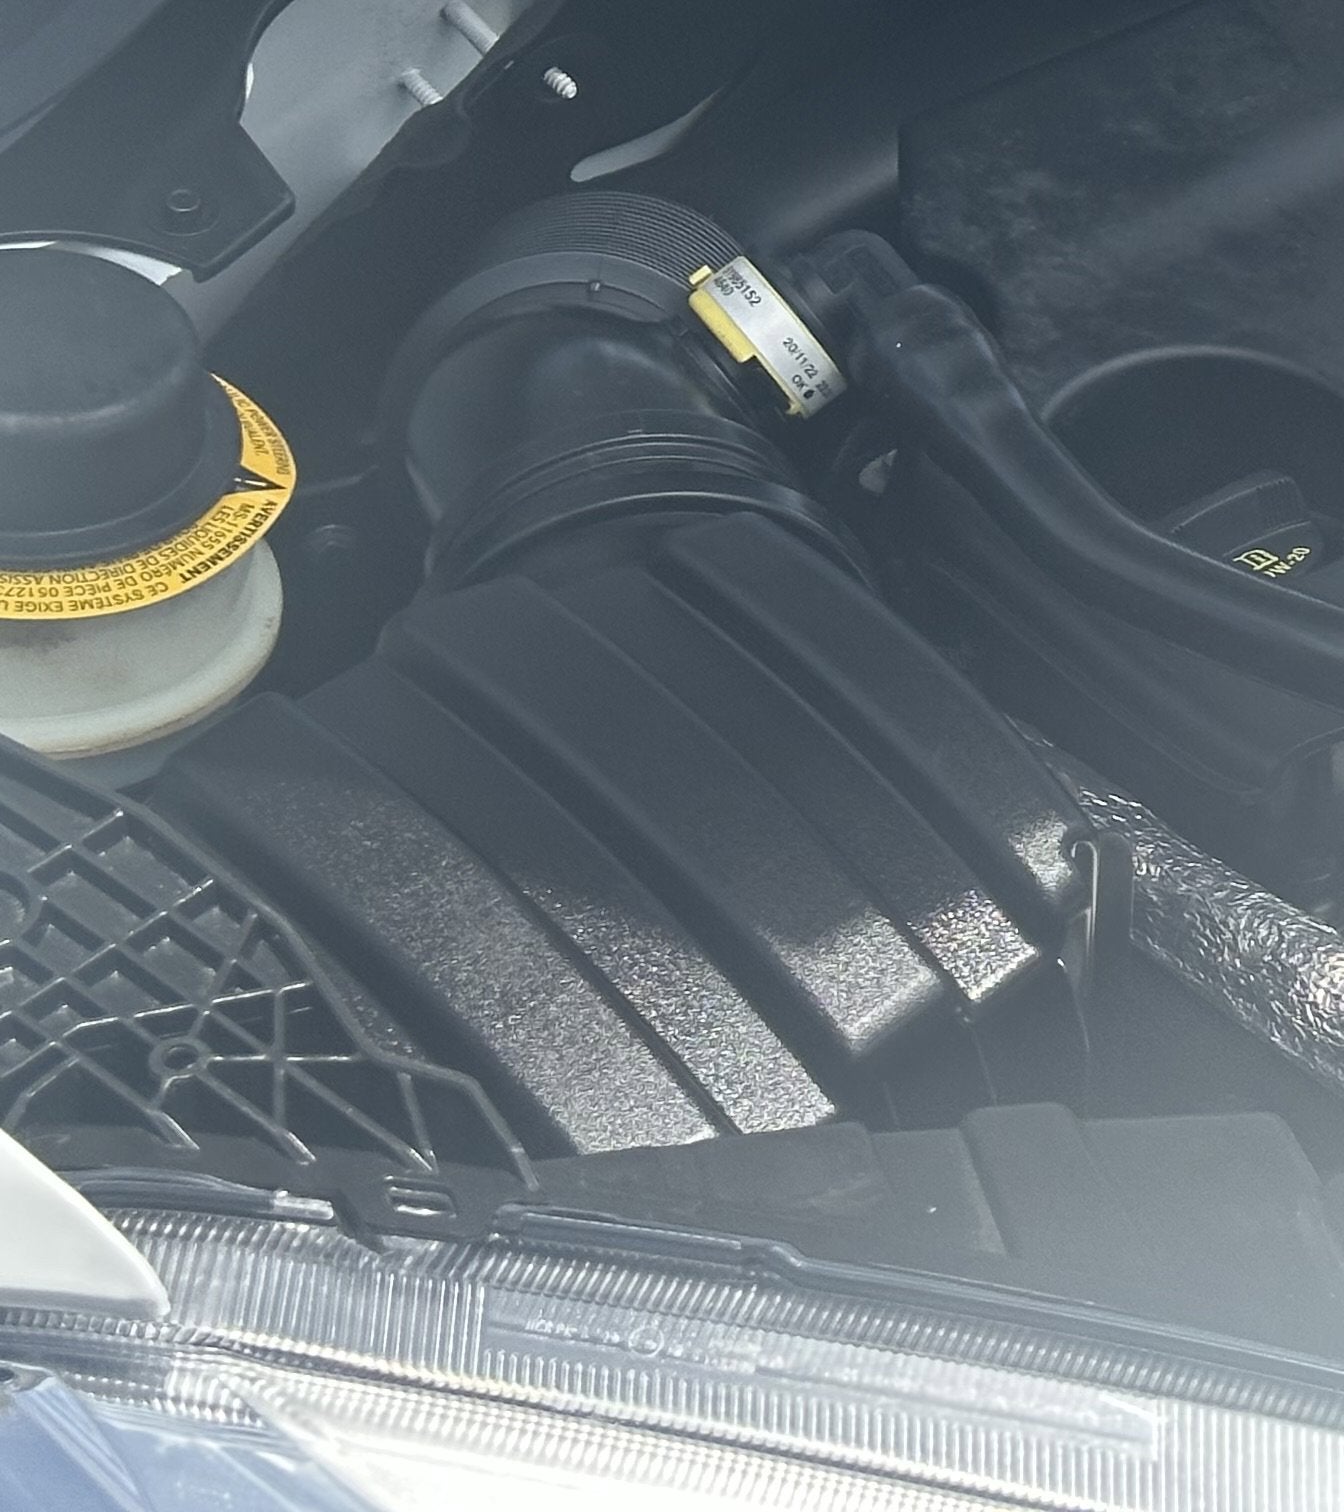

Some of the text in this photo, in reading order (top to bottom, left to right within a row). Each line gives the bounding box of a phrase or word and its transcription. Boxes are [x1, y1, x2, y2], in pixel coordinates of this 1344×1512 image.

[212, 504, 235, 524] LES
[159, 521, 217, 561] LIQUIDES
[178, 498, 278, 584] AVERTISSEMENT
[49, 562, 136, 585] DIRECTION
[136, 557, 160, 570] DE
[140, 548, 203, 583] NUMÉRO
[63, 583, 110, 597] PIÈCE
[113, 575, 138, 590] DE
[145, 581, 169, 598] CE
[14, 600, 64, 613] EXIGE
[69, 589, 145, 611] SYSTÈME
